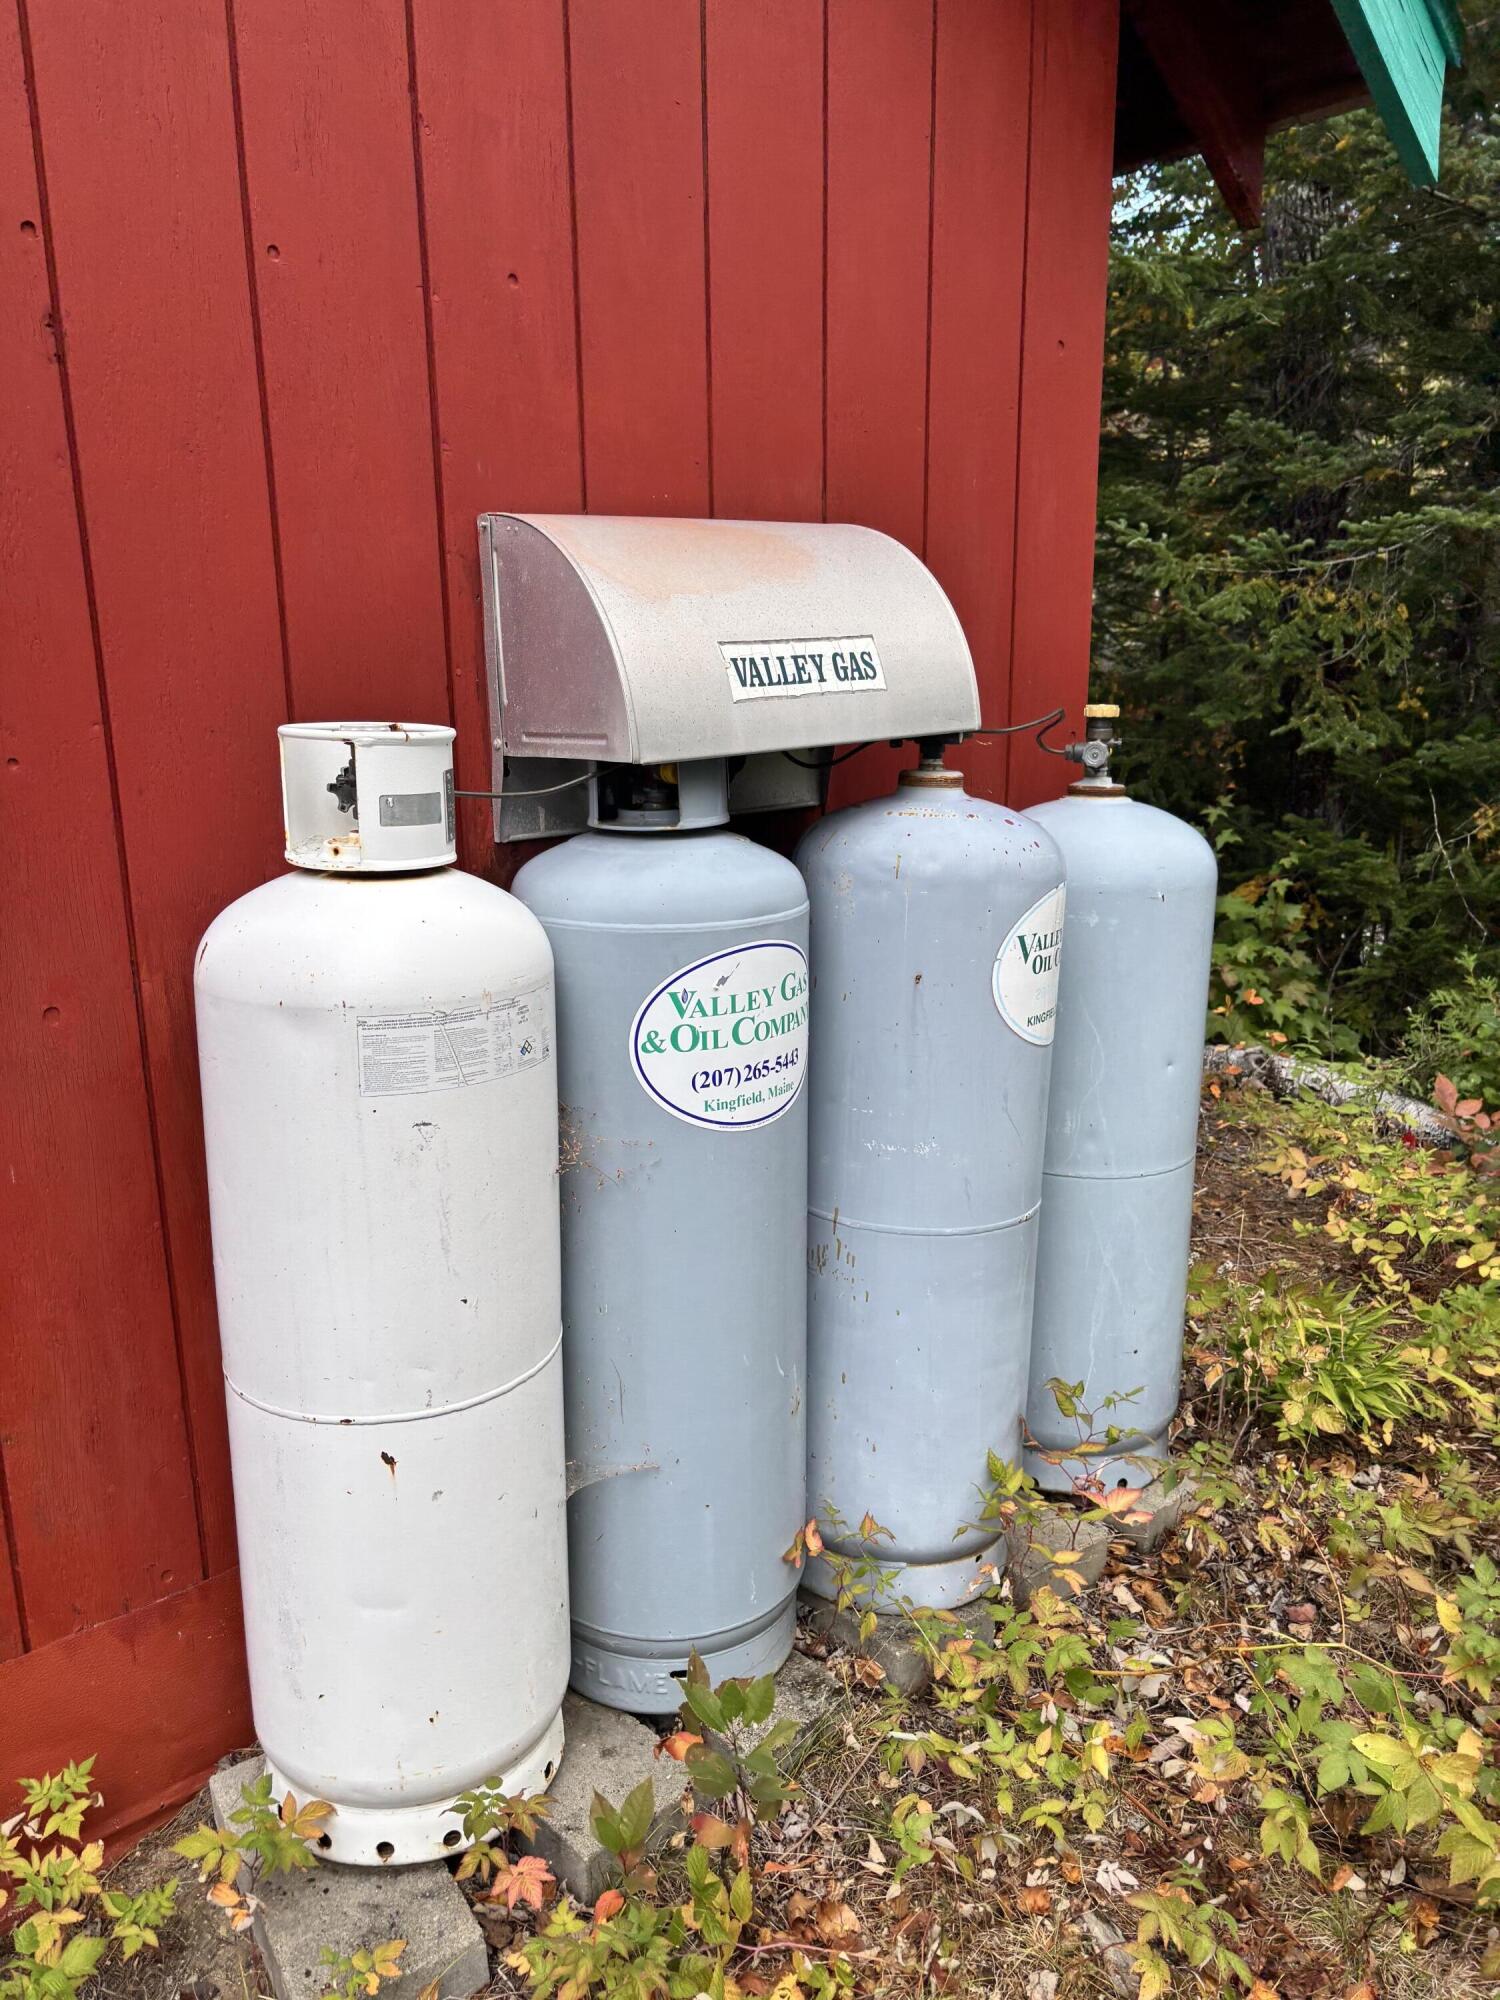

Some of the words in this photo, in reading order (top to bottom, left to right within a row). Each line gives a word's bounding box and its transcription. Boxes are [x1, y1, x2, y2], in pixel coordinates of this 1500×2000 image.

[730, 653, 827, 688] VALLEY
[831, 651, 877, 682] GAS
[1017, 927, 1062, 965] VALLE
[1032, 954, 1053, 975] OIL
[667, 985, 776, 1020] VALLEY
[780, 970, 808, 1001] GAS
[641, 1030, 667, 1054] &
[670, 1023, 729, 1053] OIL
[731, 1001, 808, 1046] COMPAN
[1026, 1007, 1056, 1028] KINGFIE
[704, 1090, 766, 1112] Kingfield,
[768, 1080, 795, 1100] Maine
